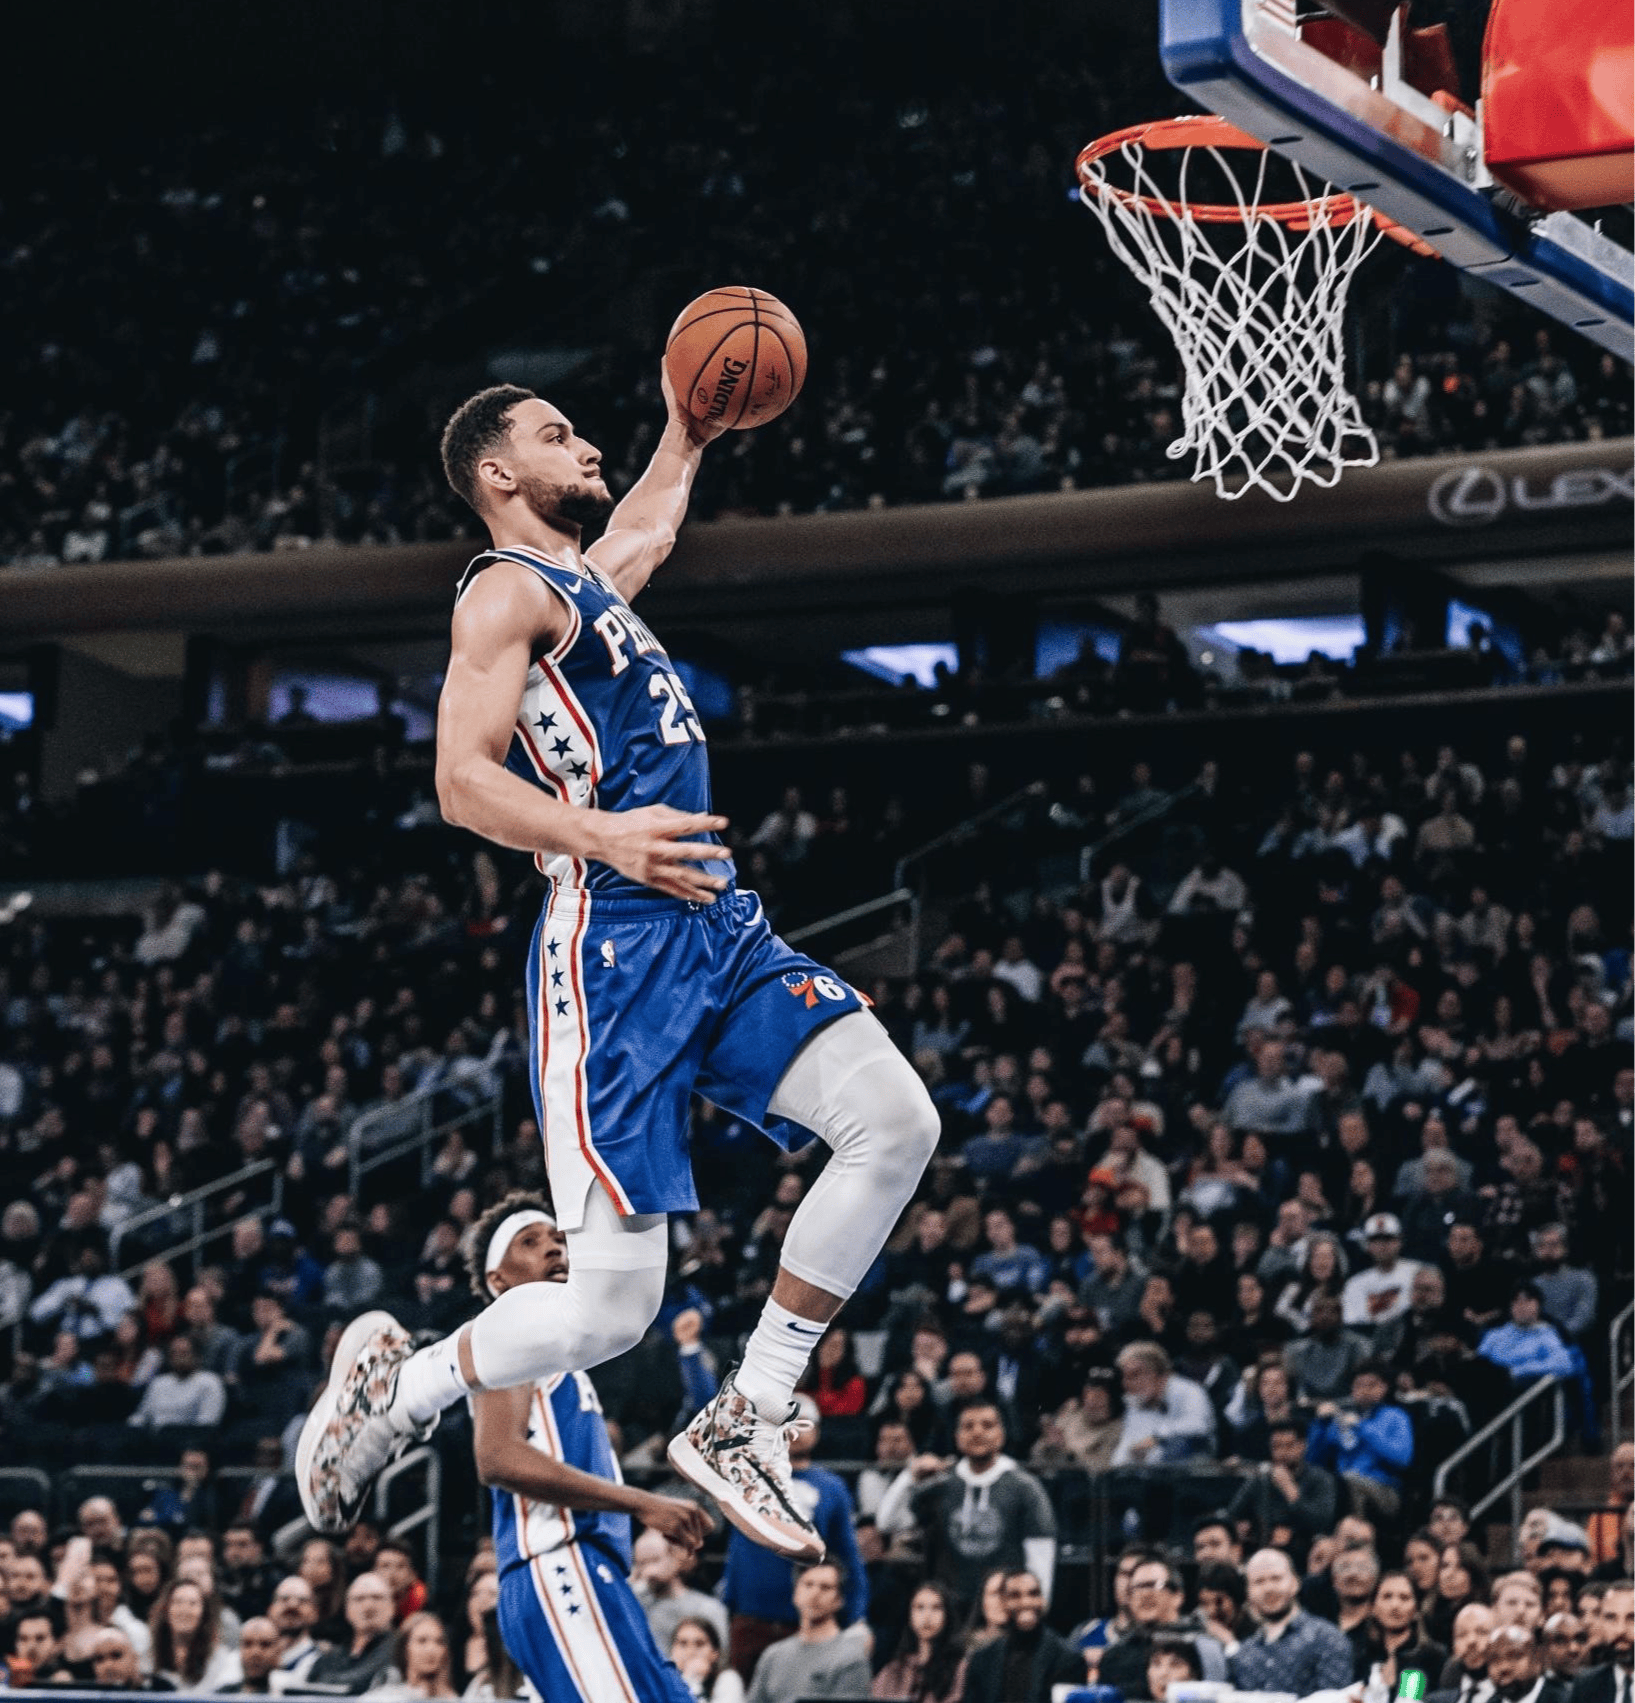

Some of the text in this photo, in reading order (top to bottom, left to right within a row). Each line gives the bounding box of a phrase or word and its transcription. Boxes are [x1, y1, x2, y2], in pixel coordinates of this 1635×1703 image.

[701, 356, 747, 423] PALDING
[649, 672, 706, 746] 25
[782, 973, 846, 1010] 76
